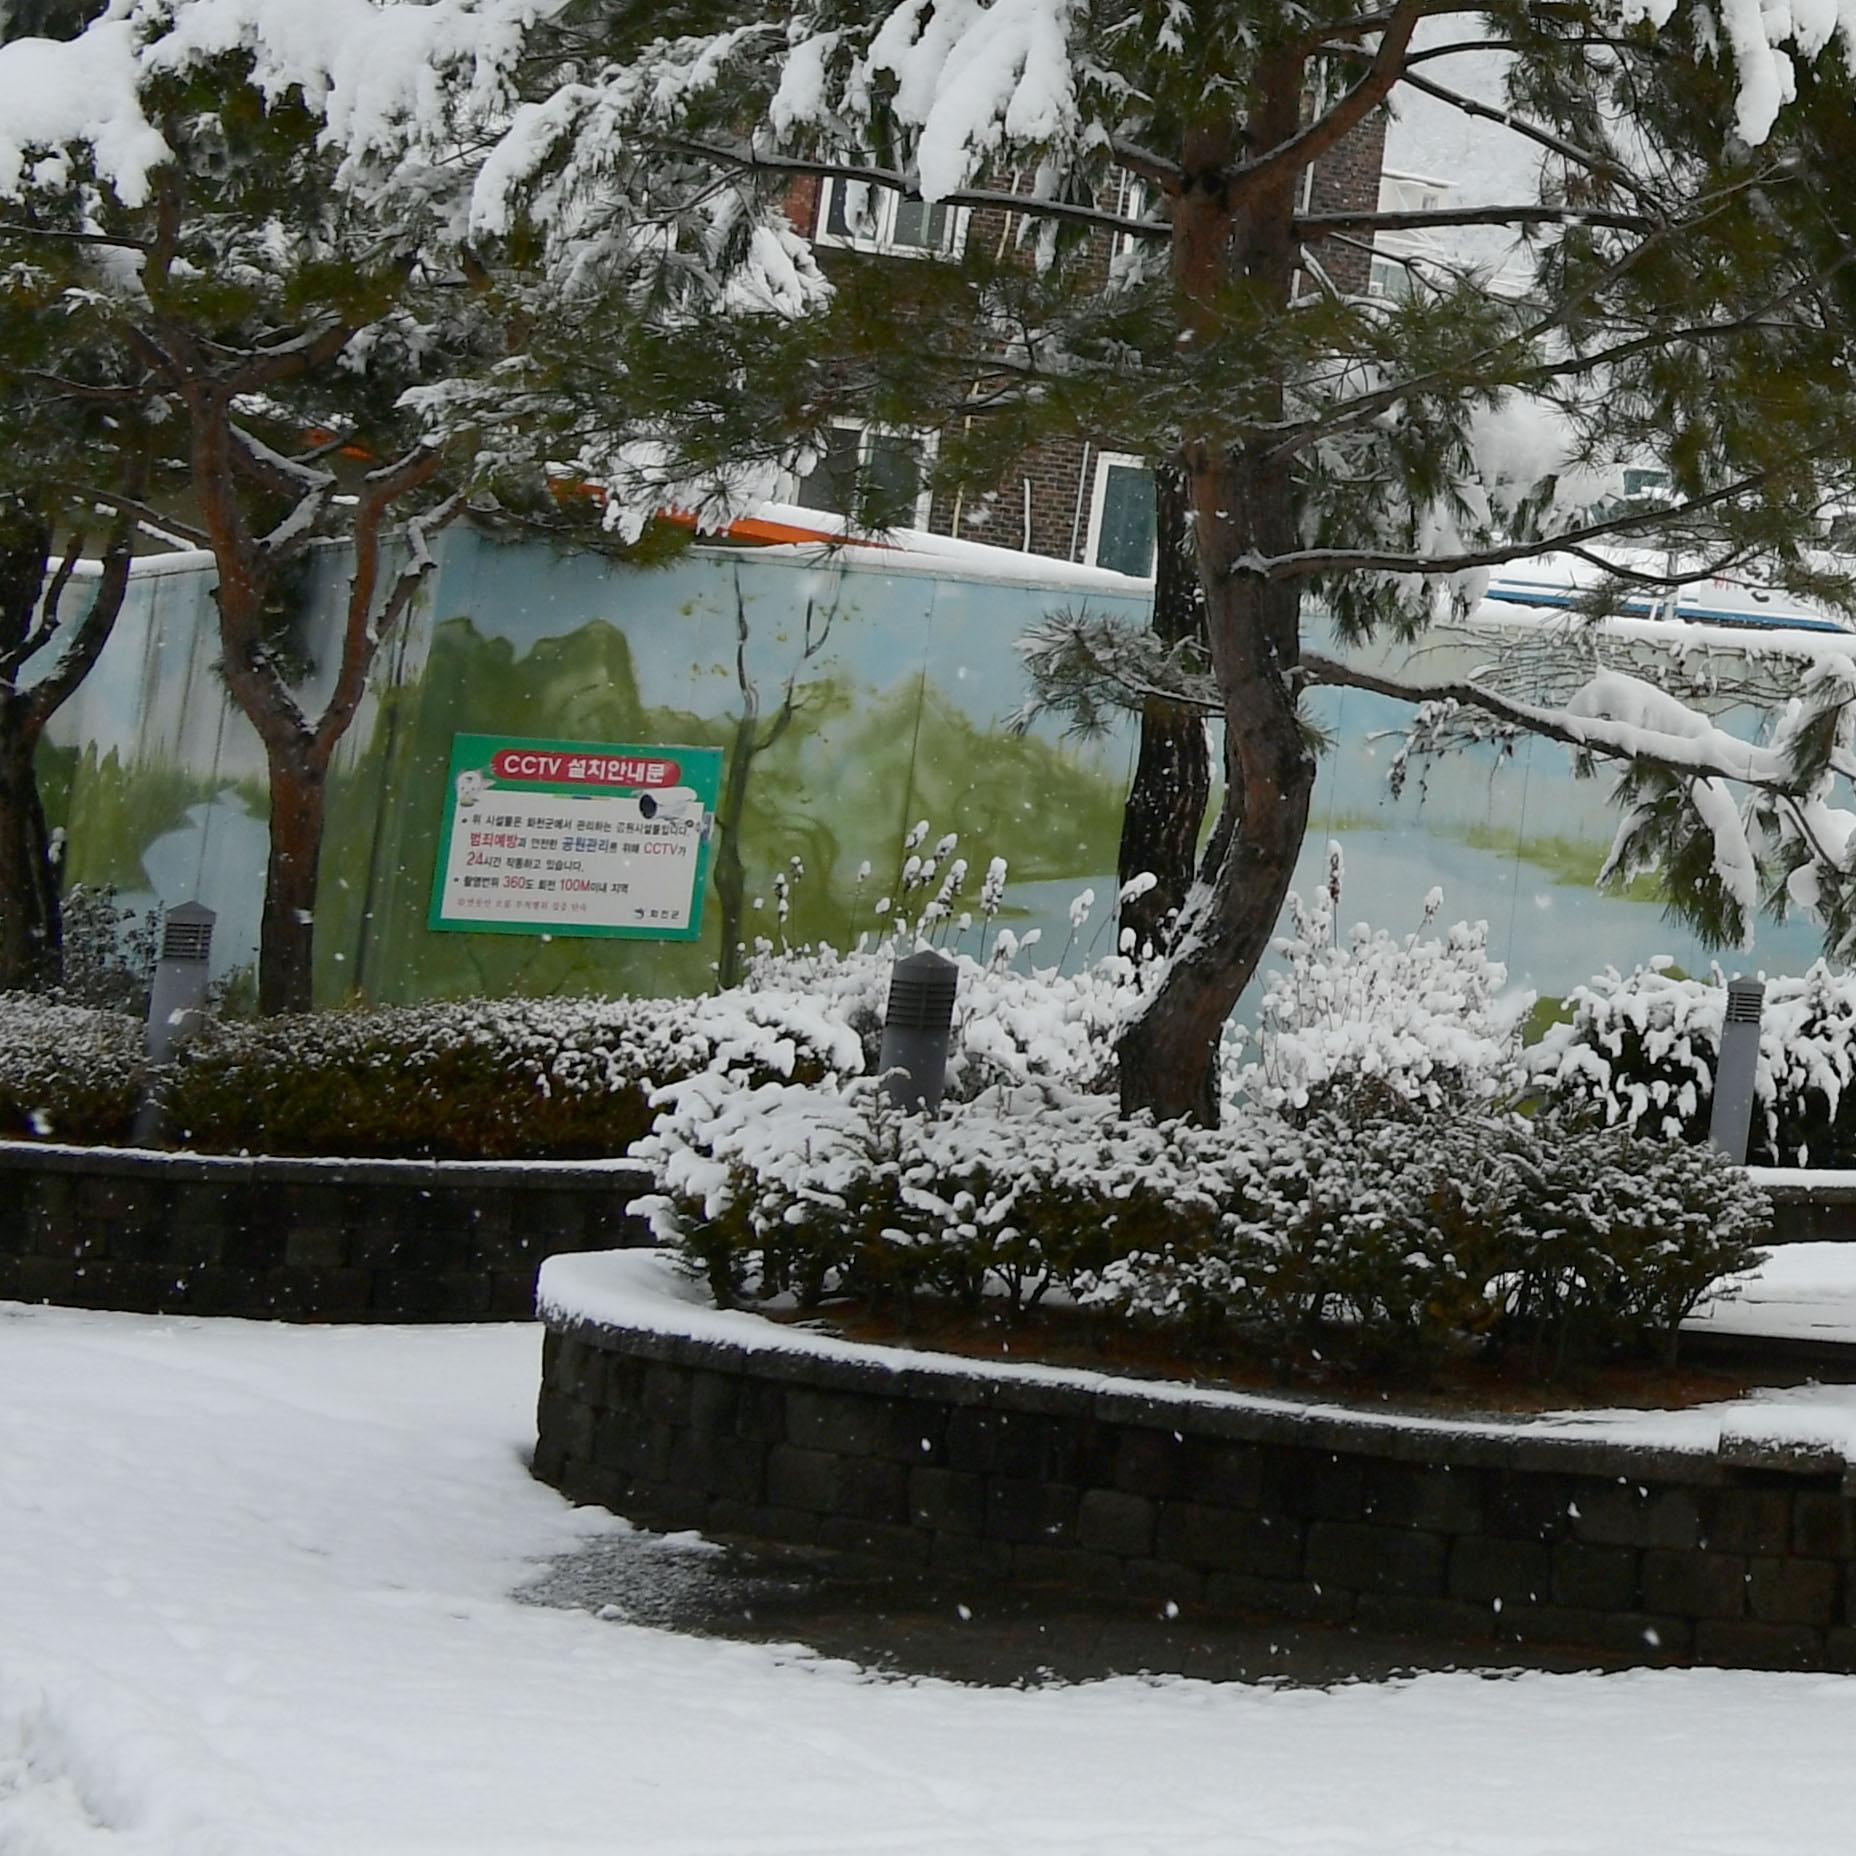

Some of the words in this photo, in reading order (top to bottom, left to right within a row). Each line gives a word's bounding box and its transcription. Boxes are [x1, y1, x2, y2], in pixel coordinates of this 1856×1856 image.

[503, 754, 562, 775] CCTV
[568, 758, 664, 784] 설치안내문
[470, 832, 526, 849] 범죄예방과
[562, 836, 617, 853] 공원관리를
[644, 842, 687, 856] CCTV가
[466, 851, 502, 868] 24시간
[503, 875, 534, 889] 360도
[560, 878, 607, 893] 100M이내
